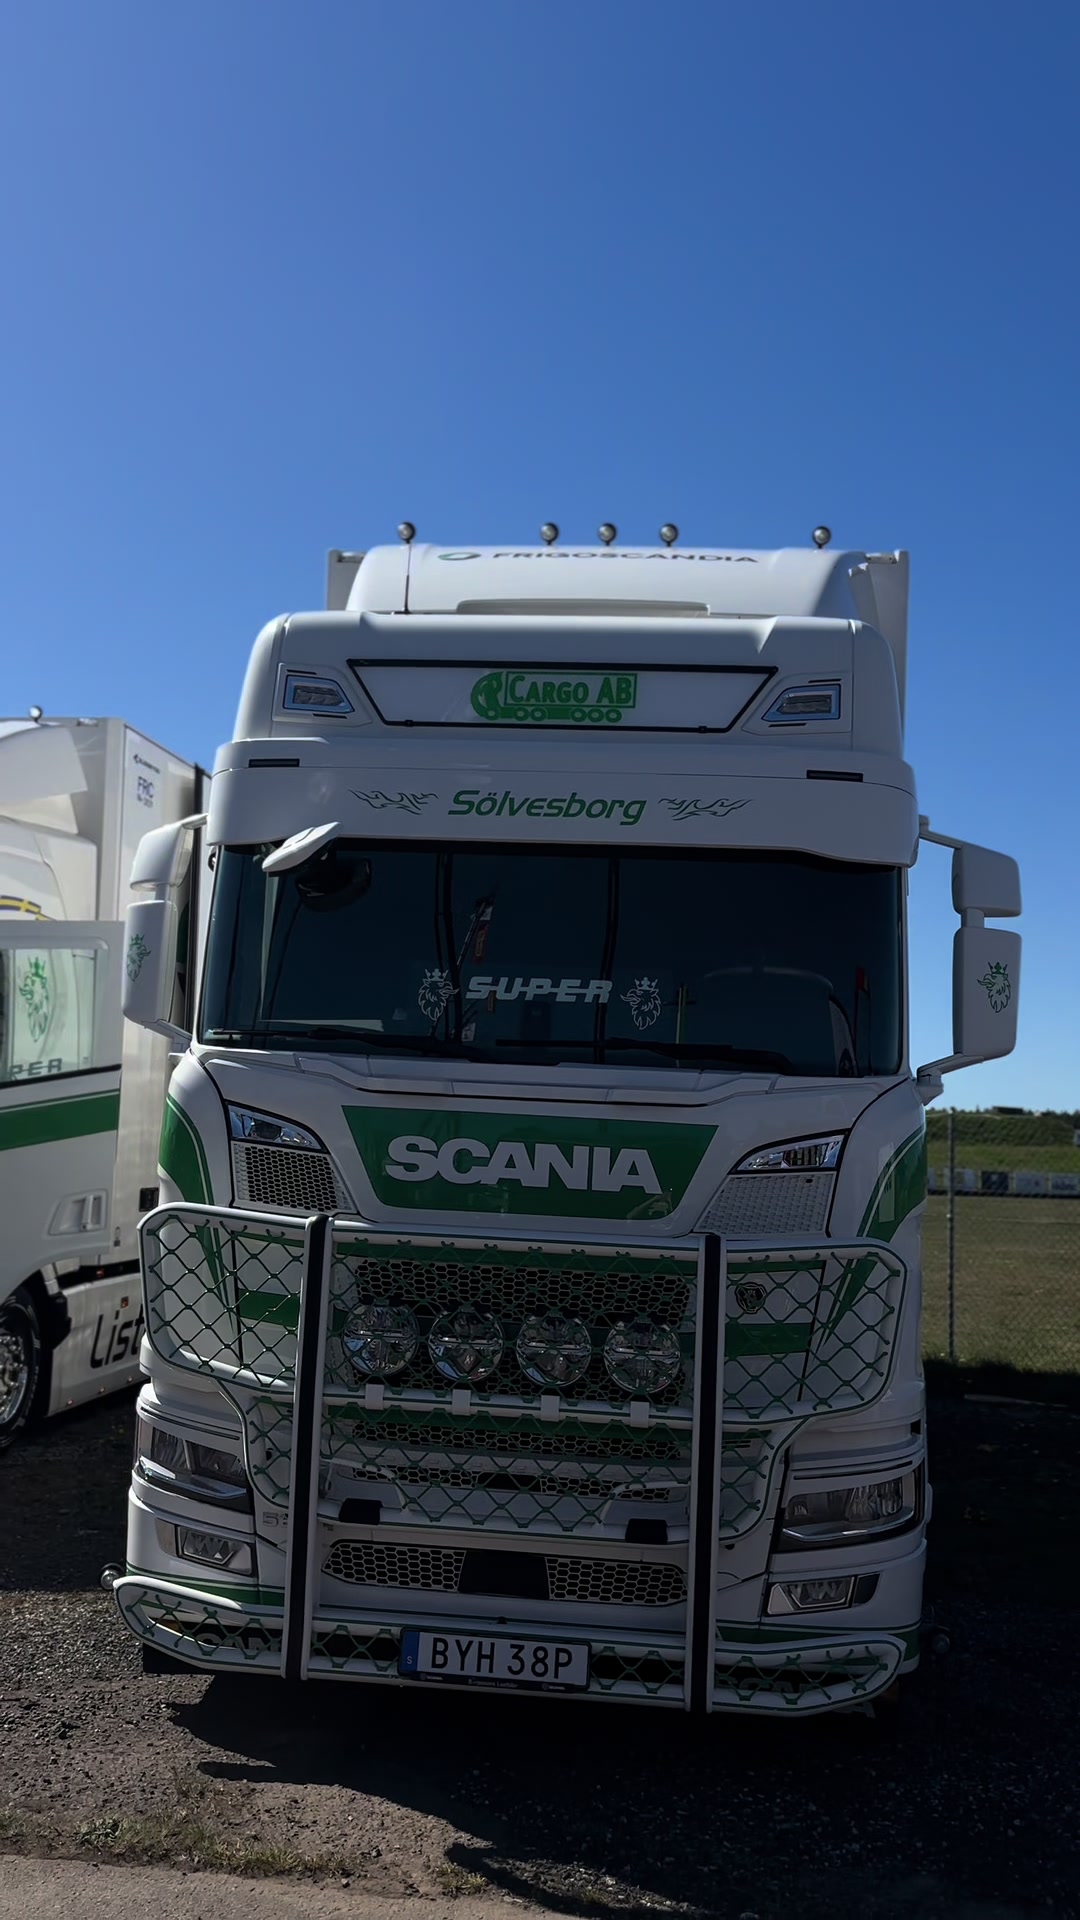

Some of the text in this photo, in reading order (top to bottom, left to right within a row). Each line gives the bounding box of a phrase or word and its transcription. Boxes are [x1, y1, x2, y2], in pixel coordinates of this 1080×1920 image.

[493, 552, 758, 564] FRIGOSCANDIA
[509, 675, 632, 705] CARGO AB
[448, 790, 647, 826] Sölvesborg
[465, 976, 613, 1003] SUPER
[385, 1135, 663, 1195] SCANIA
[406, 1655, 414, 1665] S
[431, 1637, 573, 1679] BYH 38P
